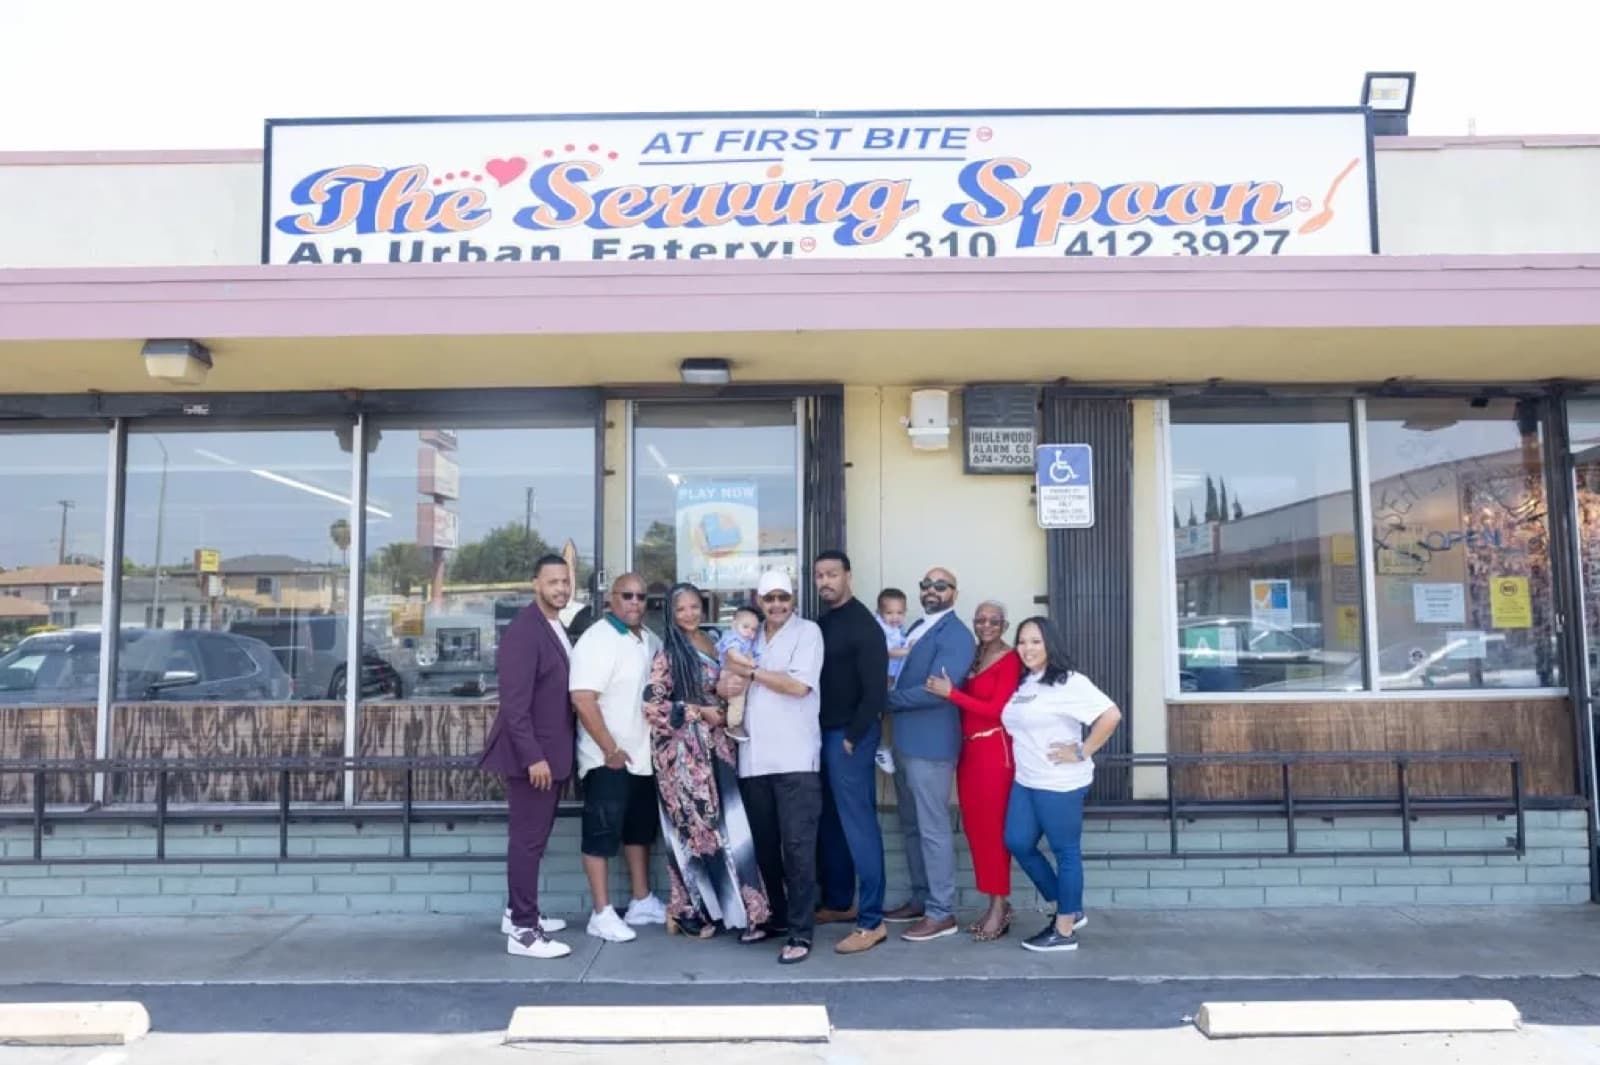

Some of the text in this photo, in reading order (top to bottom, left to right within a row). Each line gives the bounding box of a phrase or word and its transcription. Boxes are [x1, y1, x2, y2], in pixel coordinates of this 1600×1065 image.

[641, 131, 704, 154] AT
[714, 128, 853, 153] FIRST
[863, 127, 971, 149] BITE
[275, 158, 1293, 248] The Serving Spoon
[287, 241, 363, 264] An
[388, 240, 562, 263] Urban
[905, 230, 1291, 257] 310 412 3927
[971, 431, 1032, 443] INGLEWOOD
[972, 444, 1009, 454] ALARM
[972, 455, 1031, 464] 674-7000
[679, 487, 754, 500] PLAY NOW
[1425, 528, 1501, 550] OPEN
[1193, 637, 1214, 659] A
